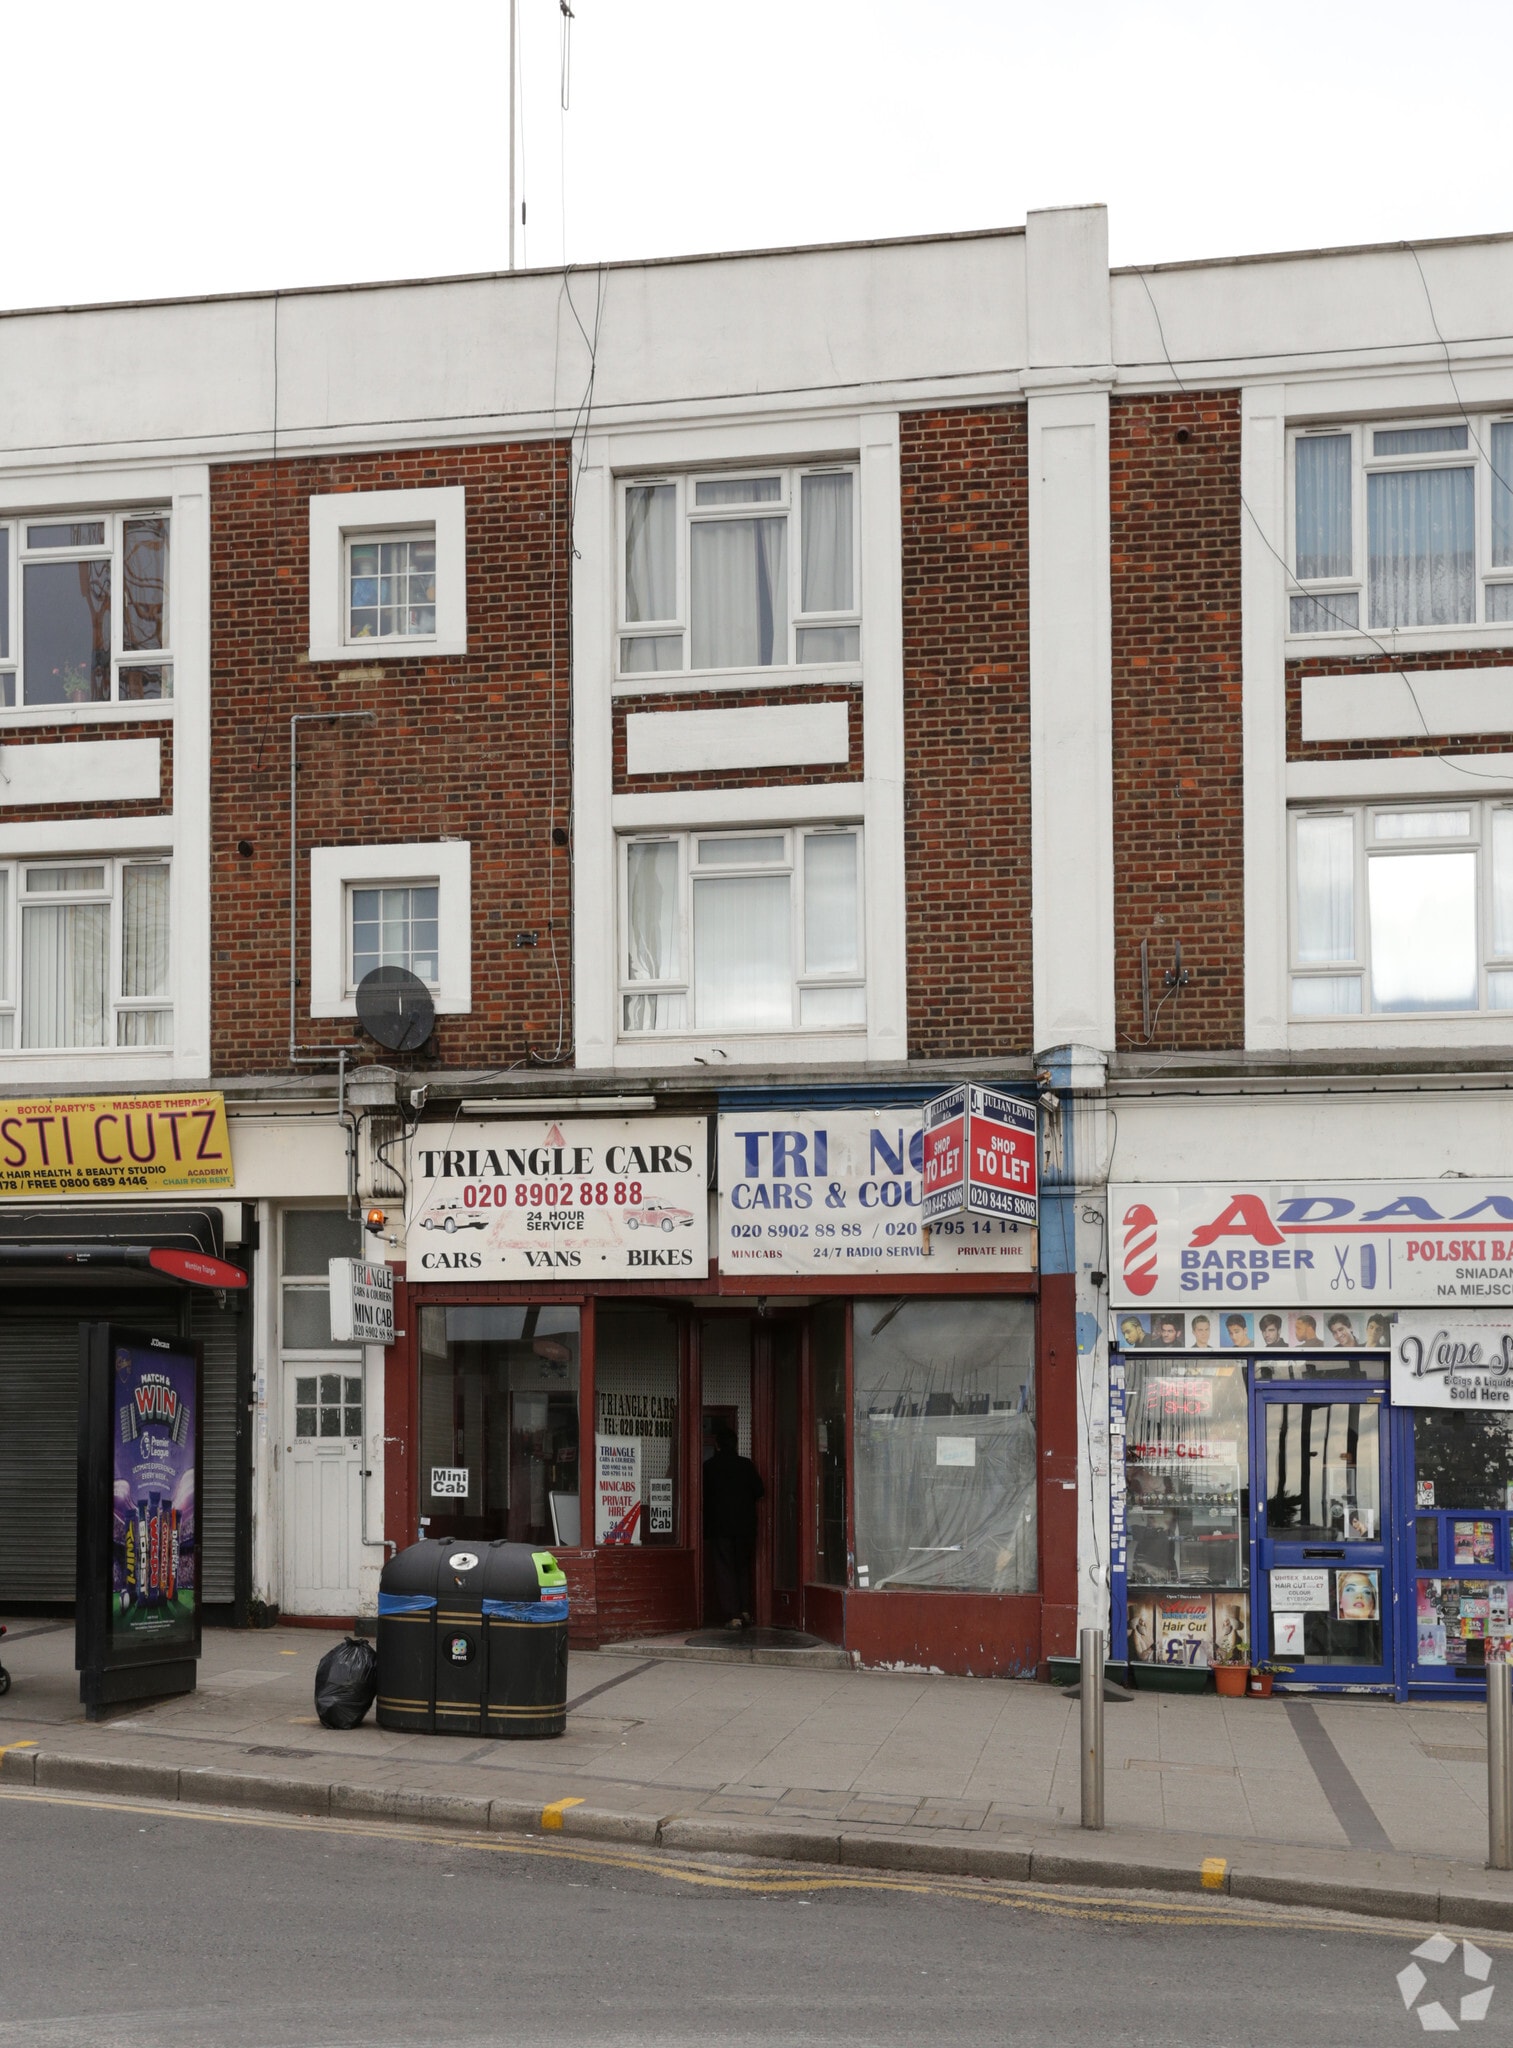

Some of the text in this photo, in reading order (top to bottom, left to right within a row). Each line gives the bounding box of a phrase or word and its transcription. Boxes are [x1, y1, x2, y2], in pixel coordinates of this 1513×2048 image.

[17, 1104, 96, 1114] BOTOX PARTY'S
[112, 1098, 211, 1110] MASSAGE THERAPY
[984, 1093, 1035, 1121] JULIAN LEWIS
[94, 1110, 223, 1165] CUTZ
[934, 1136, 950, 1156] SHOP
[991, 1136, 1016, 1155] SHOP
[418, 1144, 693, 1179] TRIANGLE CARS
[926, 1147, 960, 1184] TO LET
[976, 1148, 1030, 1184] TO LET
[6, 1170, 31, 1179] HAIR
[34, 1169, 72, 1178] HEALTH
[76, 1168, 82, 1176] &
[86, 1167, 125, 1176] BEAUTY
[128, 1166, 166, 1175] STUDIO
[188, 1168, 228, 1176] ACADEMY
[27, 1180, 58, 1189] FREE
[60, 1178, 90, 1188] 0800
[93, 1177, 116, 1187] 689
[119, 1176, 147, 1186] 4146
[163, 1178, 188, 1186] CHAIR
[210, 1176, 230, 1184] RENT
[463, 1184, 508, 1208] 020
[515, 1182, 573, 1207] 8902
[731, 1182, 813, 1210] CARS
[824, 1182, 846, 1209] &
[972, 1187, 1036, 1218] 020 8445 8808
[526, 1210, 585, 1221] 24 HOUR
[526, 1220, 584, 1231] SERVICE
[730, 1224, 762, 1238] 020
[768, 1224, 809, 1238] 8902
[814, 1223, 836, 1238] 88
[841, 1222, 862, 1237] 88
[885, 1222, 918, 1236] 020
[972, 1220, 992, 1234] 14
[998, 1221, 1019, 1234] 14
[731, 1249, 783, 1259] MINICABS
[813, 1248, 842, 1260] 24/7
[846, 1247, 882, 1258] RADIO
[958, 1246, 996, 1256] PRIVATE
[1000, 1246, 1024, 1256] HIRE
[1406, 1240, 1486, 1262] POLSKI
[422, 1249, 693, 1269] CARS VANS BIKES
[1181, 1250, 1315, 1270] BARBER
[352, 1264, 392, 1290] TRIANGLE
[1180, 1271, 1270, 1291] SHOP
[354, 1286, 366, 1298] CARS
[370, 1288, 392, 1302] COURIERS
[1437, 1284, 1513, 1296] NA MIEJSC
[354, 1302, 392, 1328] MINI CAB
[1400, 1330, 1482, 1378] Vape
[141, 1374, 164, 1384] MATCH
[1474, 1376, 1480, 1386] &
[1484, 1376, 1513, 1388] Liquid
[1450, 1388, 1510, 1400] Sold Here
[135, 1385, 176, 1419] WIN
[600, 1392, 676, 1419] TRIANGLE CARS
[1165, 1400, 1210, 1414] SHOP
[620, 1418, 634, 1436] 020
[635, 1420, 653, 1437] 8902
[151, 1436, 170, 1447] Premier
[151, 1448, 170, 1459] League
[600, 1446, 635, 1458] TRIANGLE
[434, 1470, 466, 1482] Mini
[434, 1482, 466, 1494] Cab
[600, 1481, 635, 1492] MINICABS
[602, 1495, 632, 1506] PRIVATE
[608, 1507, 626, 1516] HIRE
[651, 1508, 671, 1518] Mini
[651, 1518, 670, 1529] Cab
[139, 1520, 147, 1592] BOOST
[1160, 1600, 1207, 1614] Adam
[1162, 1622, 1207, 1631] Hair Cut
[1166, 1638, 1202, 1664] £7
